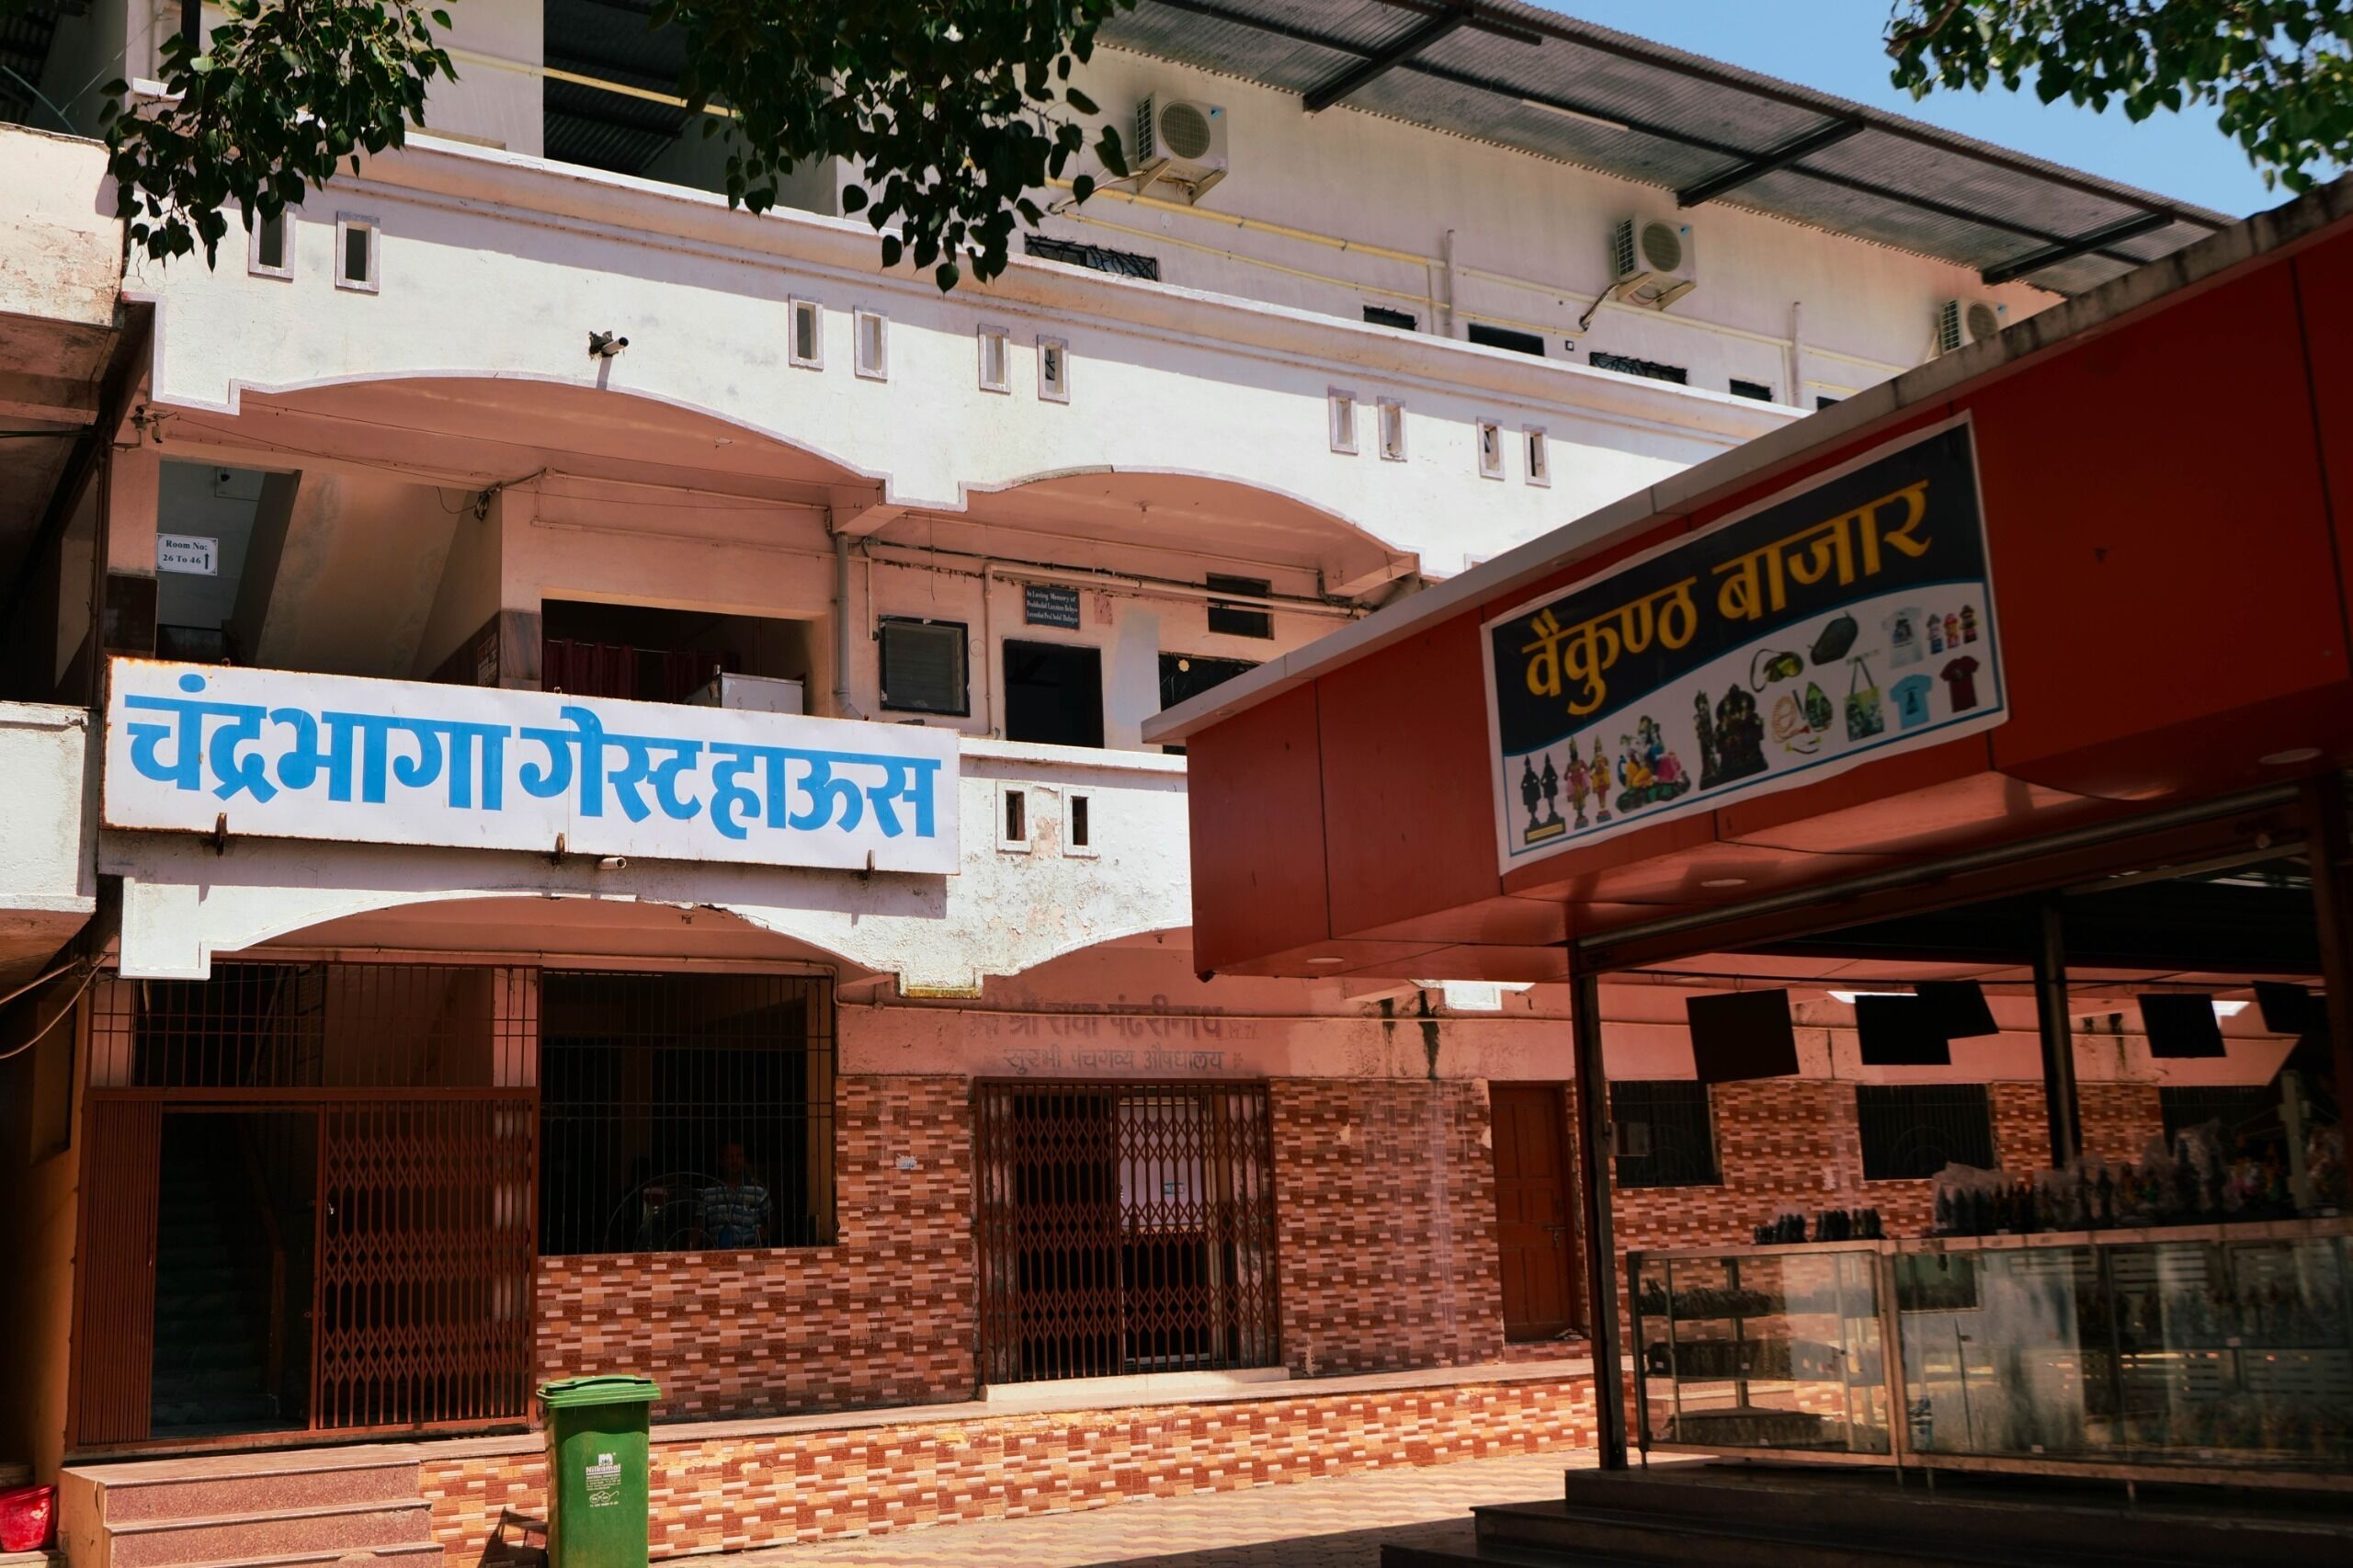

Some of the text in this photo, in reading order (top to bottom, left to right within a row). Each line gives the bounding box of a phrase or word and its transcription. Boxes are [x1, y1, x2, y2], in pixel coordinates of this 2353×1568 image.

[165, 540, 208, 551] Room No:
[163, 553, 174, 562] 26
[1522, 481, 1931, 715] वैकुण्ठ बाजार
[125, 674, 941, 839] चंद्रभागा गेस्ट हाऊस
[585, 1463, 621, 1473] Nilkamal
